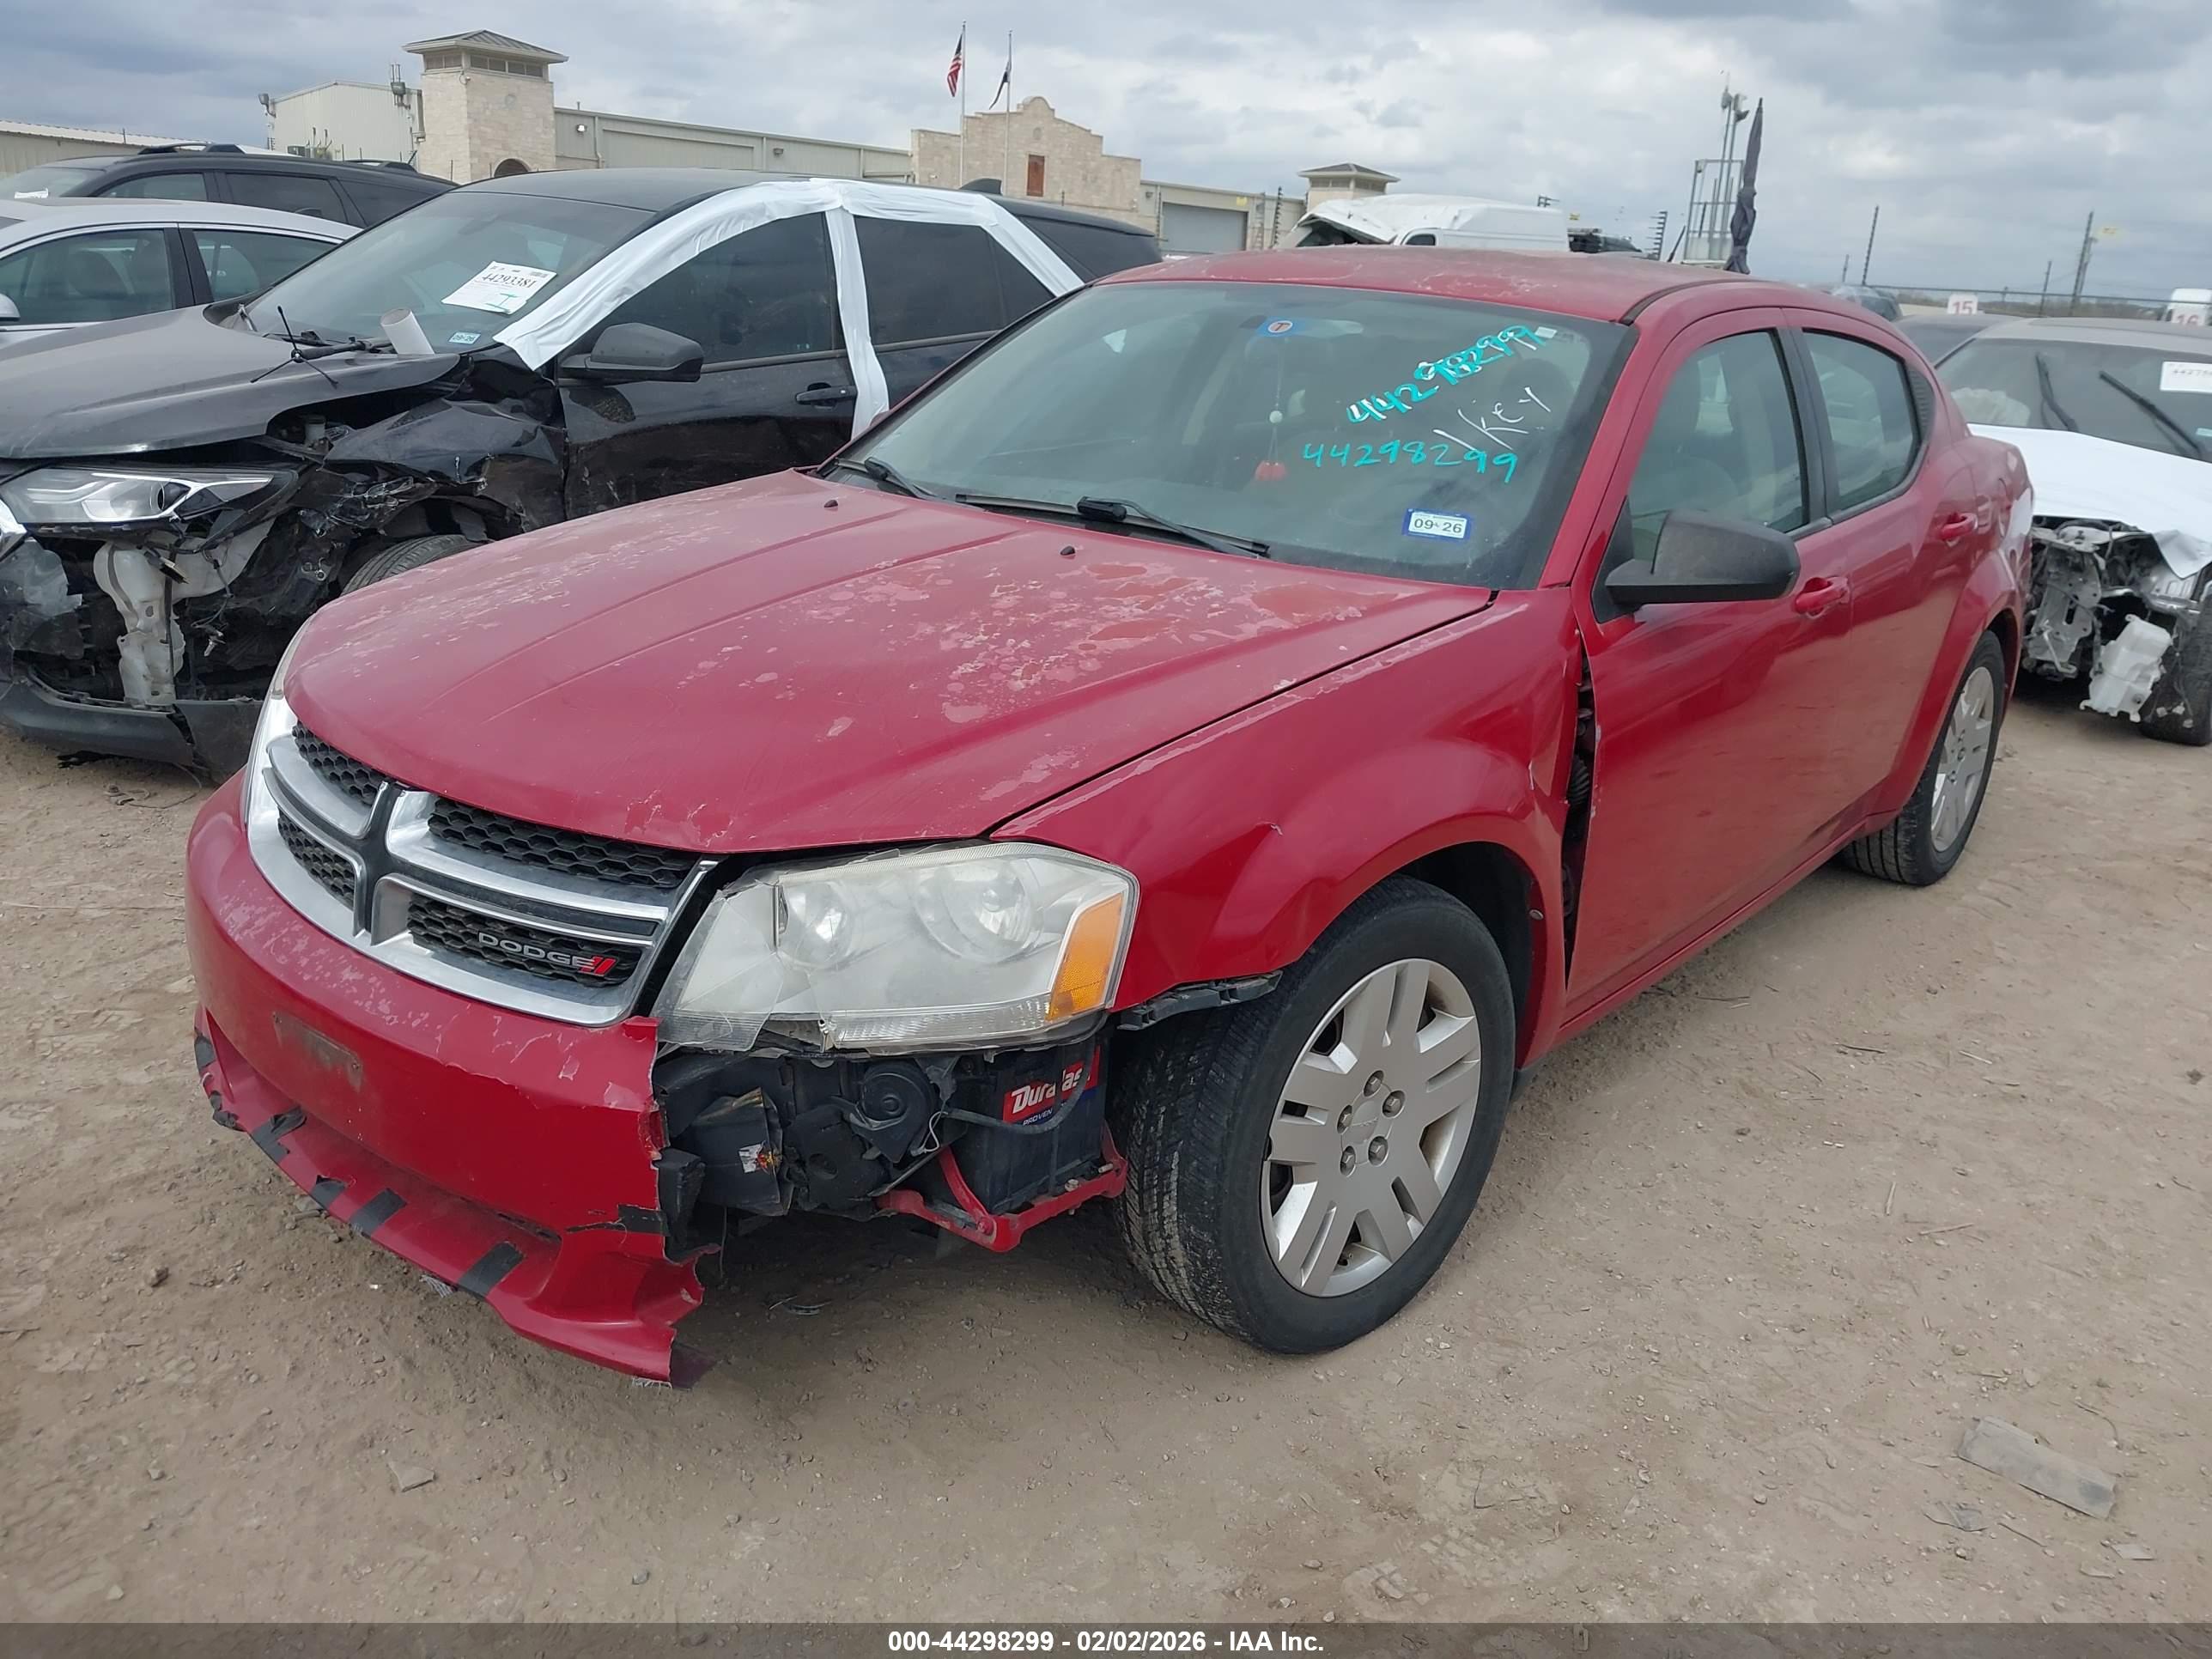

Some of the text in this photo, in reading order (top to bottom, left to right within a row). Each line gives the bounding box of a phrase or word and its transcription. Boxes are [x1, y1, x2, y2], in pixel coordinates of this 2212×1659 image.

[1952, 301, 1972, 316] 15
[1303, 439, 1518, 483] 44298299
[478, 932, 596, 970] DODGE
